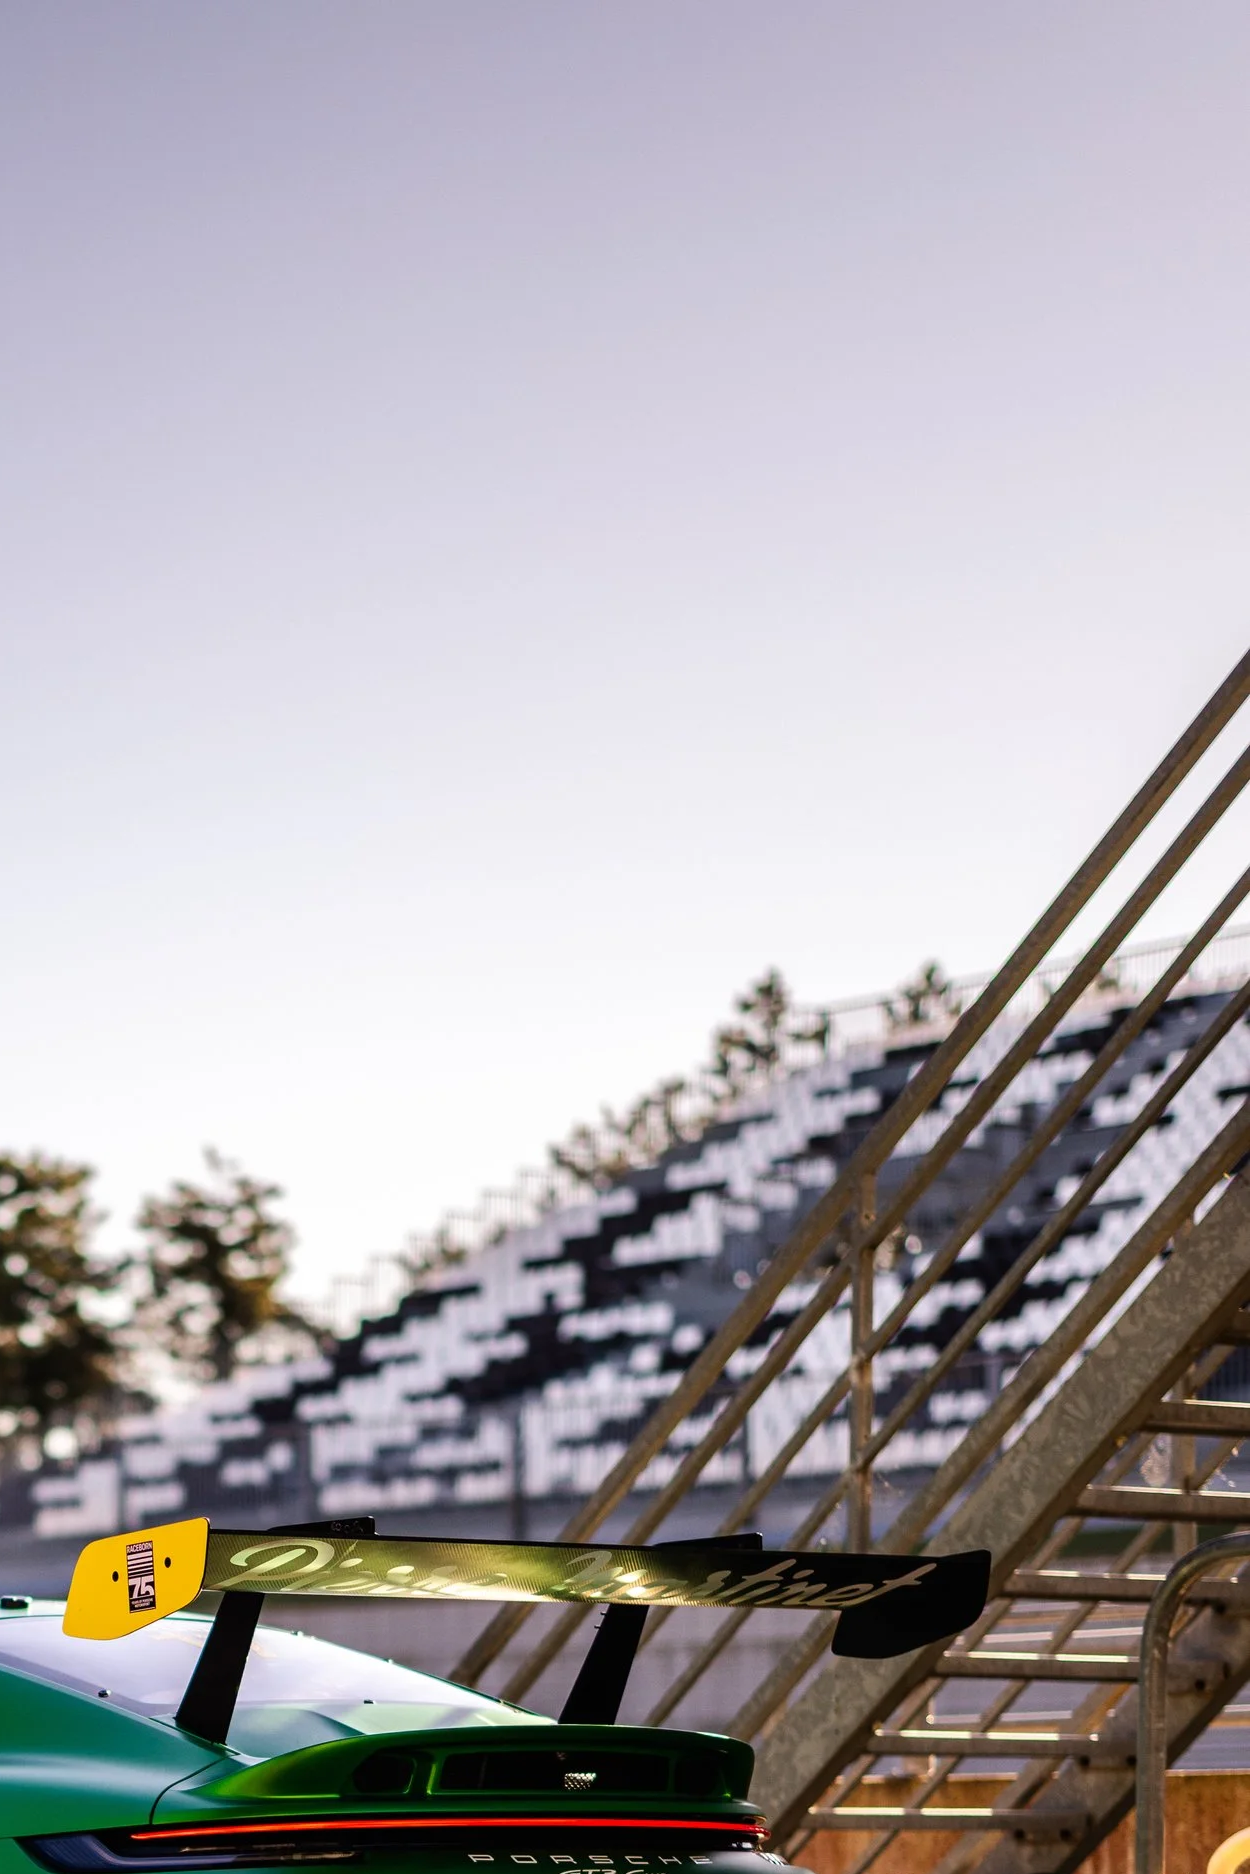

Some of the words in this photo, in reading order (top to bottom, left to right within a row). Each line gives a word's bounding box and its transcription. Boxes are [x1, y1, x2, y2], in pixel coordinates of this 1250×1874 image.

[126, 1541, 153, 1553] RACEBORN
[129, 1574, 155, 1600] 75
[467, 1854, 714, 1865] PORSCHE
